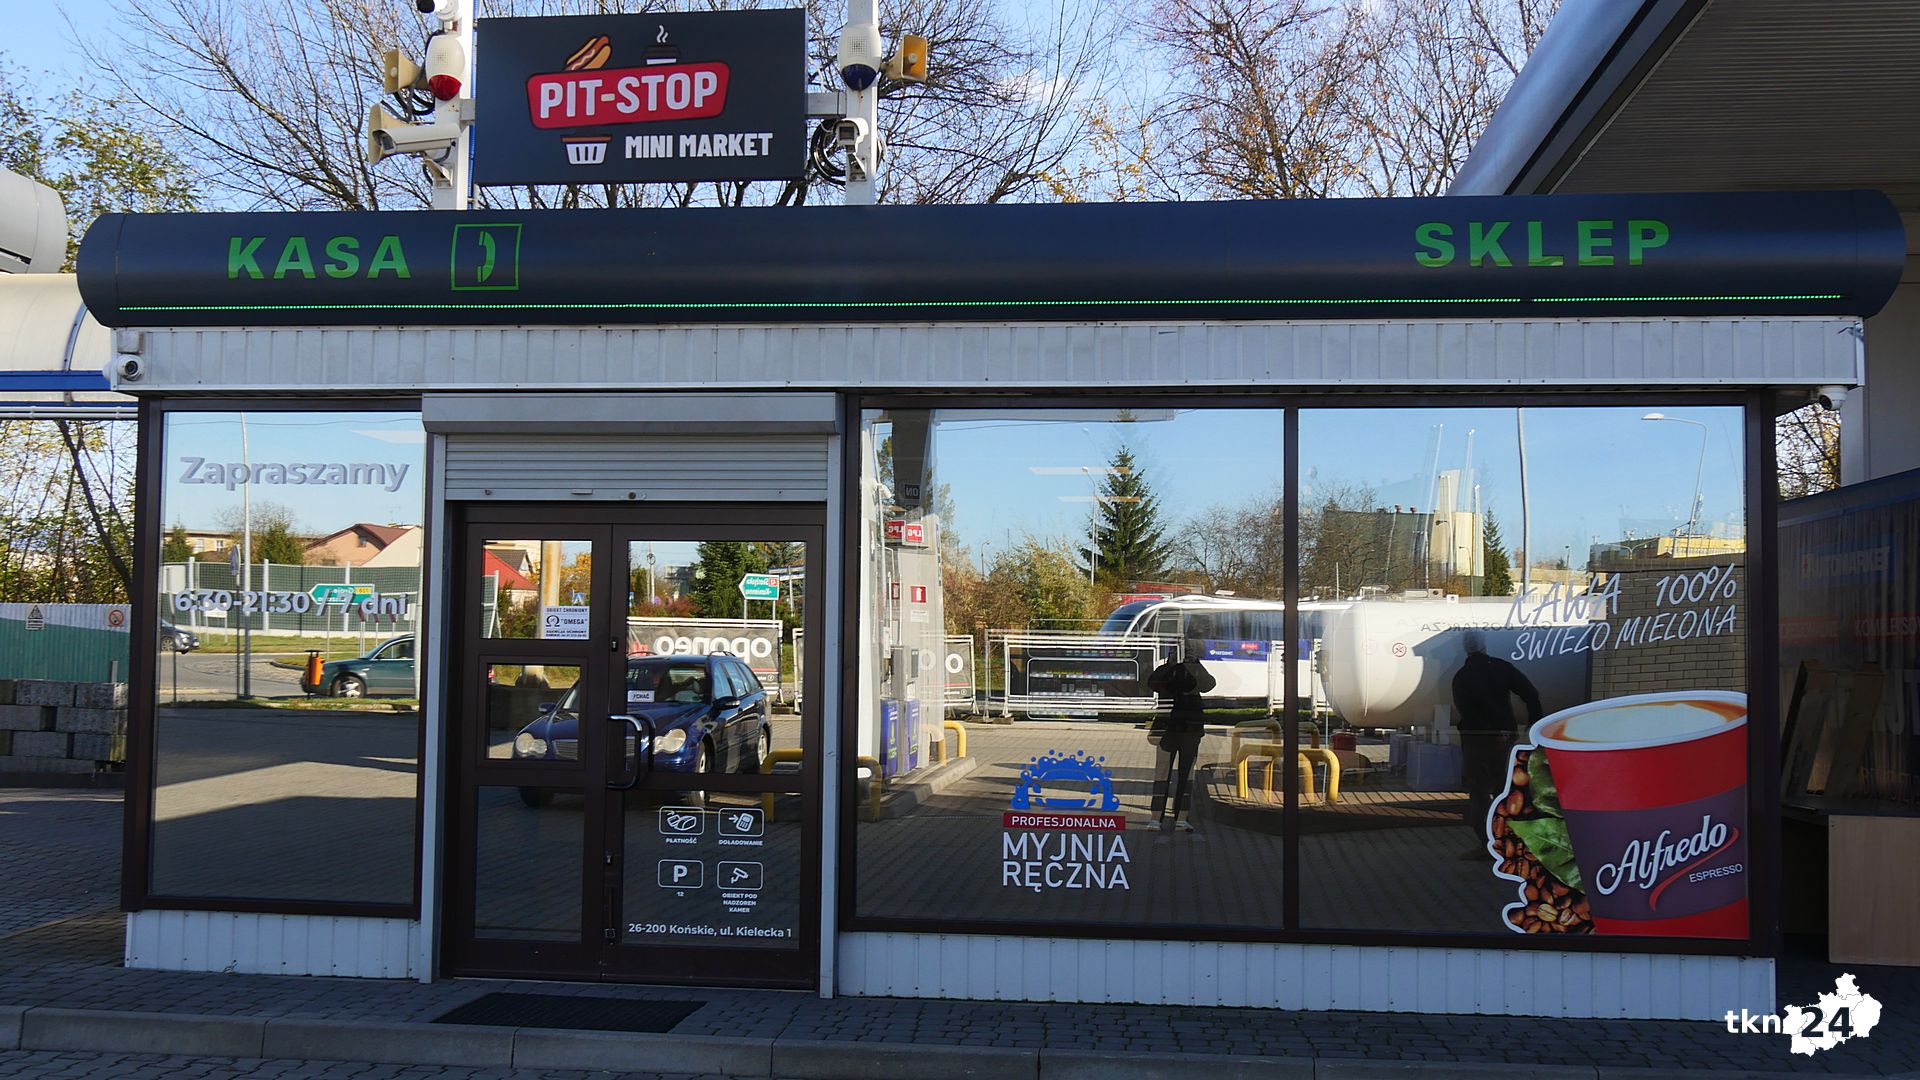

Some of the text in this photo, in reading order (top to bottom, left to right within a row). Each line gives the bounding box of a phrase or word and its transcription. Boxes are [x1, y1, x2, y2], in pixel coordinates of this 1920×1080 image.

[540, 71, 718, 119] PIT-STOP
[625, 133, 773, 159] MINI MARKET
[228, 236, 411, 279] KASA
[1414, 220, 1670, 268] SKLEP
[179, 456, 410, 493] Zapraszamy
[174, 590, 311, 614] 6:30-21:30
[339, 591, 355, 614] 7
[361, 592, 408, 615] dni
[1507, 562, 1738, 629] KAWA 100%
[1615, 605, 1737, 650] MIELONA
[1011, 815, 1117, 829] PROFESJONALNA
[1003, 832, 1131, 863] MYJNIA
[1596, 815, 1728, 895] Alfredo
[673, 865, 688, 883] P
[1003, 861, 1130, 893] RĘCZNA
[1689, 863, 1743, 883] ESPRESSO
[628, 923, 792, 937] 26-200 Końskie, ul. Kielecka 1
